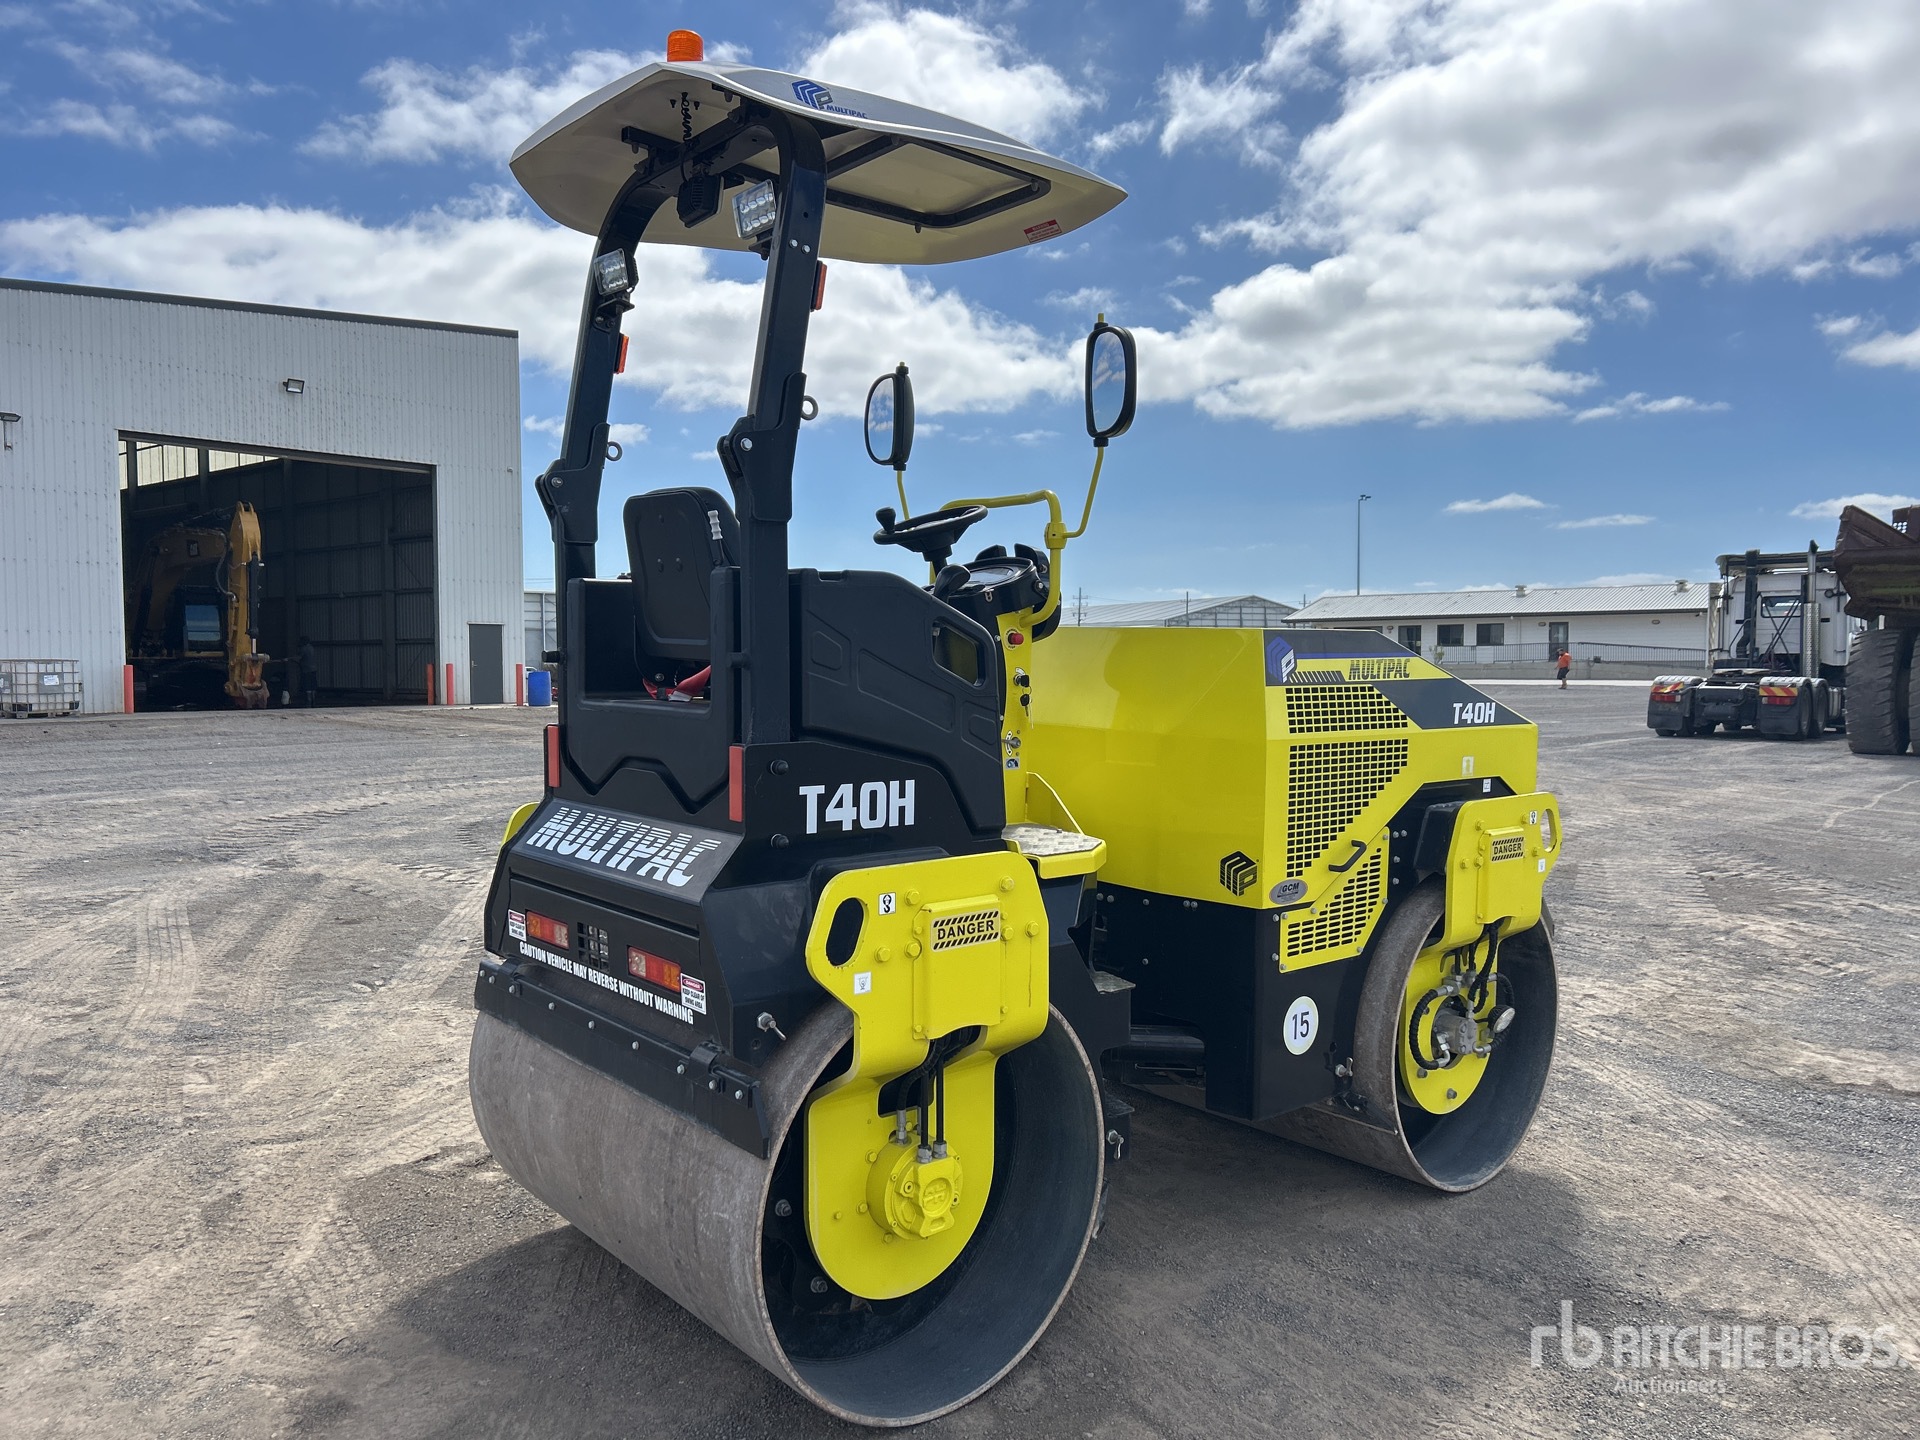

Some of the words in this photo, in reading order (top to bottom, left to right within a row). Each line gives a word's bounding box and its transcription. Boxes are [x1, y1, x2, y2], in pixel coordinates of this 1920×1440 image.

[826, 105, 868, 119] MULTIPAC
[1349, 659, 1410, 680] MULTIPAC
[1452, 702, 1496, 725] T40H
[799, 779, 915, 834] T40H
[526, 806, 721, 887] MULTIPAC
[1494, 843, 1522, 855] DANGER
[1281, 882, 1300, 893] GCM
[937, 920, 995, 940] DANGER
[520, 941, 546, 963] CAUTION
[547, 952, 573, 974] VEHICLE
[573, 962, 587, 979] MAY
[588, 967, 618, 992] REVERSE
[619, 980, 654, 1007] WITHOUT
[654, 995, 694, 1025] WARNING
[1291, 1011, 1310, 1040] 15
